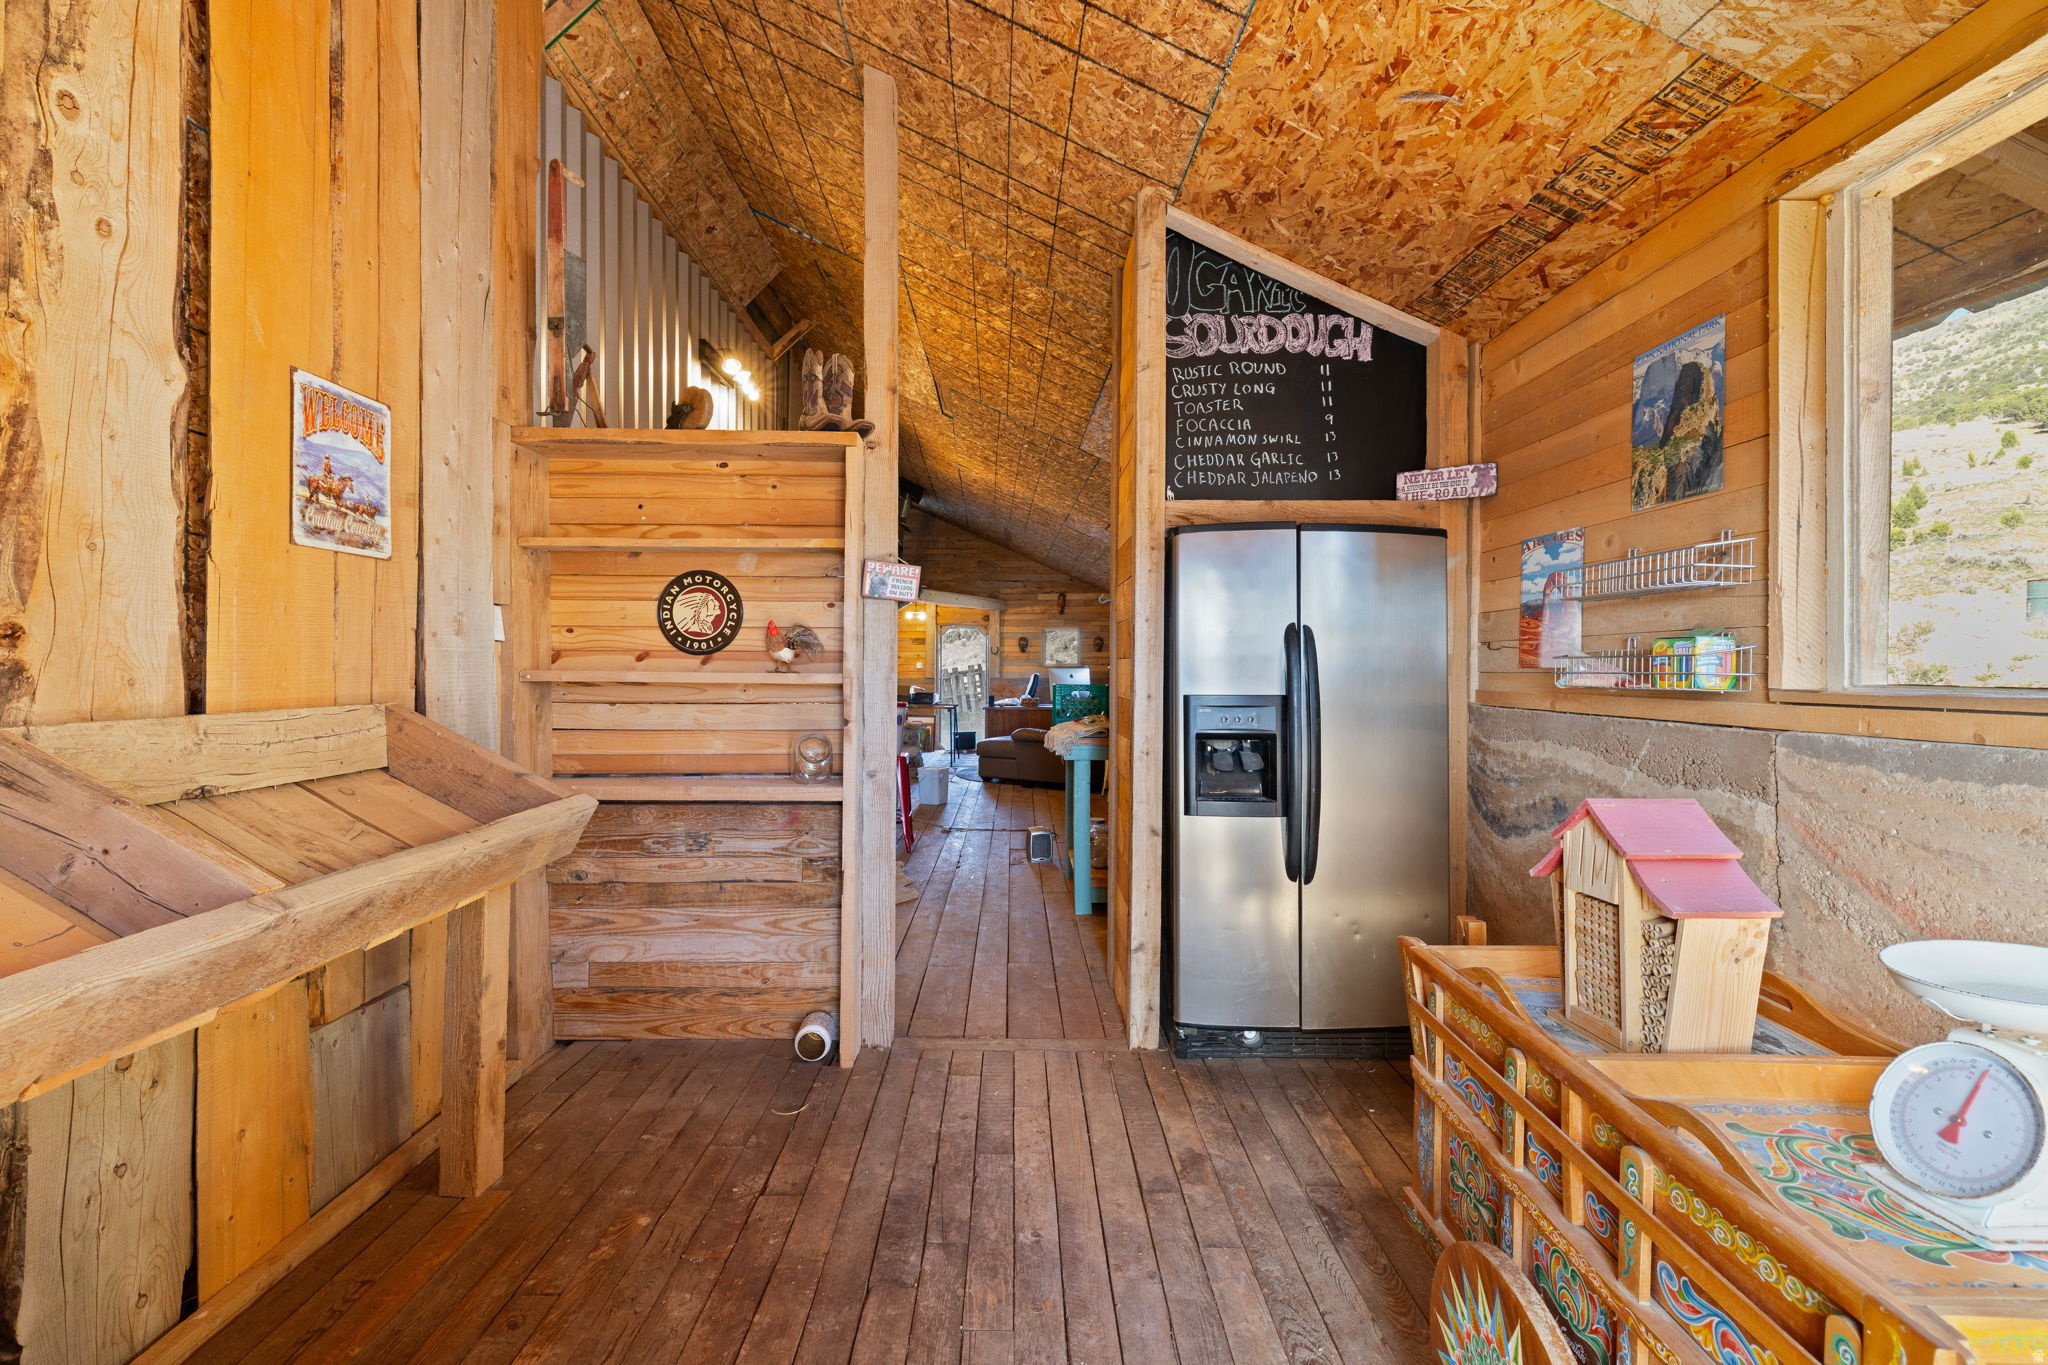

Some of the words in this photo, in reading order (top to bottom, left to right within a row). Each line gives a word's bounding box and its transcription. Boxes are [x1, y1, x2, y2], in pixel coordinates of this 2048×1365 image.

[1166, 312, 1374, 362] SOURDOUGH
[1656, 331, 1695, 355] NATIONAL
[1698, 319, 1720, 335] PARK
[1172, 364, 1222, 382] RUSTIC
[1229, 361, 1287, 376] ROUND
[1320, 364, 1330, 376] 11
[1171, 383, 1227, 399] CRUSTY
[1234, 382, 1276, 395] LONG
[1321, 381, 1332, 391] 11
[1174, 399, 1244, 415] TOASTER
[1322, 397, 1333, 407] 11
[301, 384, 385, 464] WELCOME
[1176, 418, 1251, 435] FOCACCIA
[1325, 414, 1333, 424] 9
[1175, 434, 1257, 449] CINNAMON
[1263, 433, 1302, 445] SWIRL
[1325, 431, 1336, 442] 13
[1174, 454, 1245, 470] CHEDDAR
[1250, 452, 1304, 468] GARLIC
[1327, 452, 1339, 463] 13
[1174, 471, 1249, 488] CHEDDAR
[1251, 471, 1318, 487] JALAPENO
[1329, 469, 1341, 481] 13
[1403, 471, 1444, 485] NEVER
[1447, 468, 1470, 480] LET
[1403, 491, 1428, 500] THE
[1435, 487, 1468, 499] ROAD
[1407, 482, 1430, 492] STUMBLE
[305, 506, 343, 537] Cowboy
[344, 516, 381, 543] Country
[1523, 529, 1584, 553] ARCHES
[866, 561, 919, 577] BEWARE!
[890, 583, 913, 591] BULLDOG
[662, 585, 680, 636] INDIAN
[683, 575, 737, 636] MOTORCYCLE
[686, 640, 714, 650] 1901
